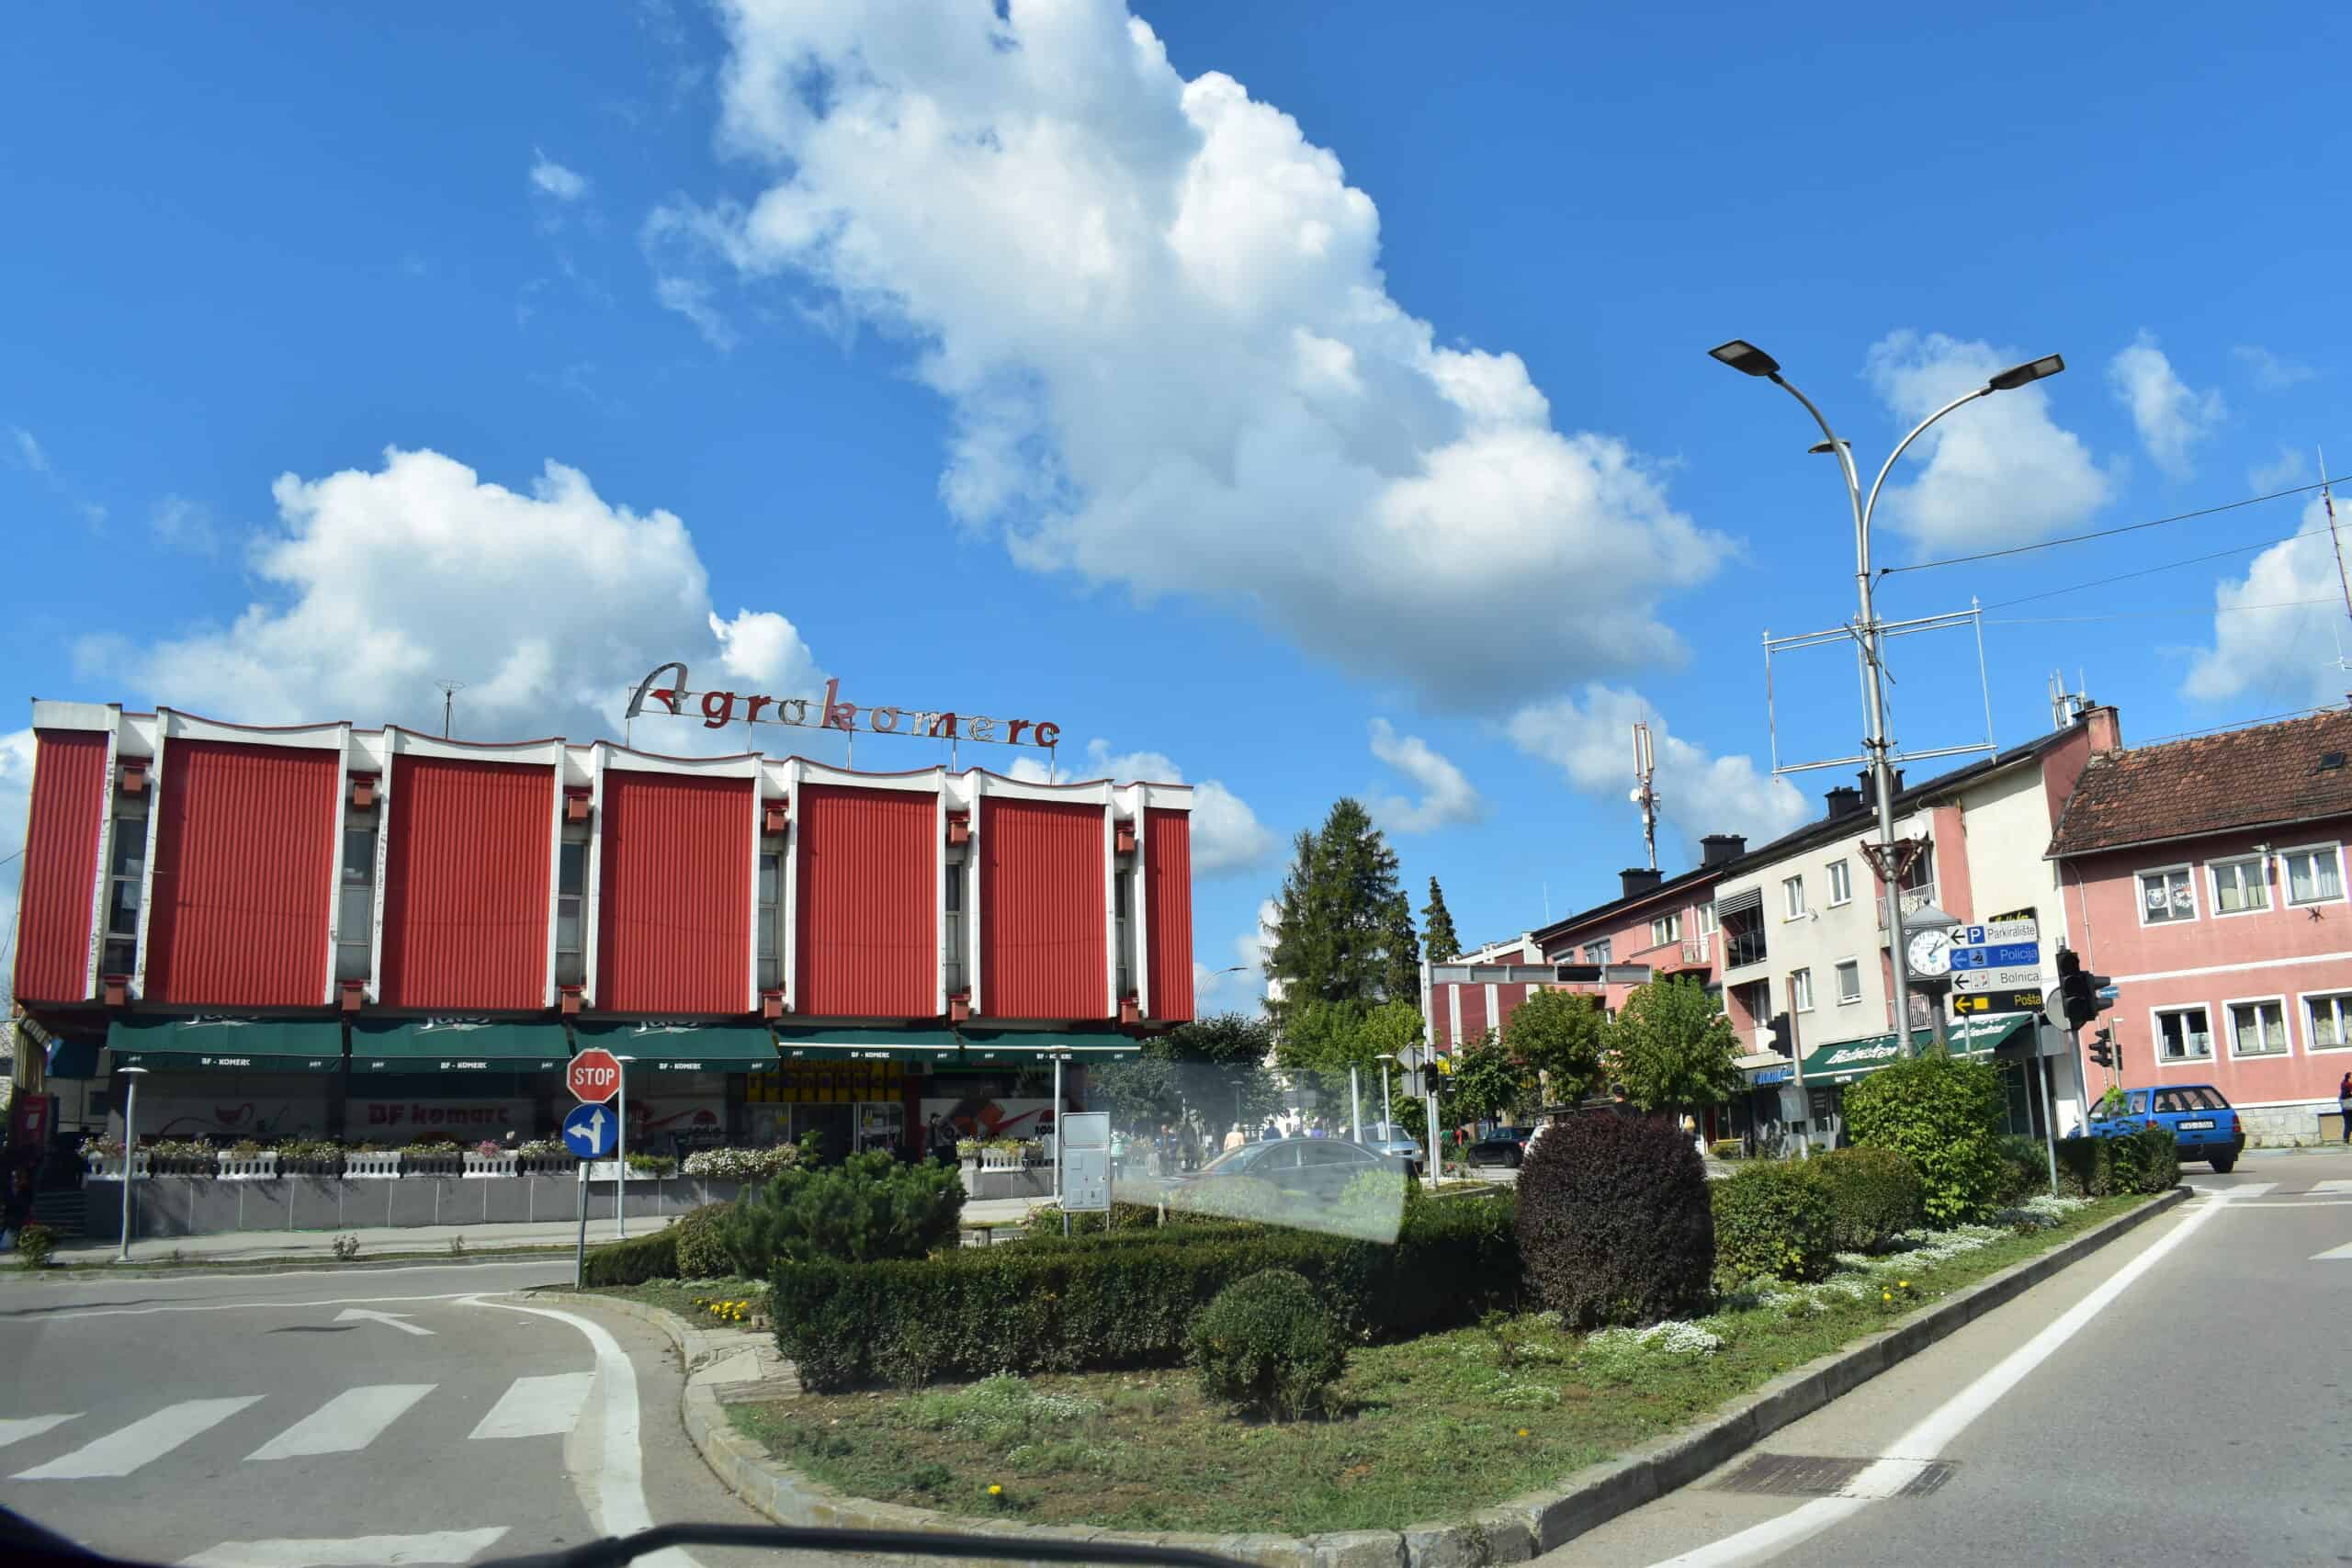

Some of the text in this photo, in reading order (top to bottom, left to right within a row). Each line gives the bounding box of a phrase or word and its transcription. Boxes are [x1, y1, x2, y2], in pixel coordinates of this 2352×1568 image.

[625, 661, 1060, 748] Agrokomerc
[1987, 926, 2036, 941] Parkiralište
[2000, 949, 2038, 963] Policija
[2000, 971, 2040, 984] Bolnica
[2014, 994, 2041, 1007] Pošta
[219, 1058, 250, 1066] KOMERC
[574, 1067, 616, 1086] STOP
